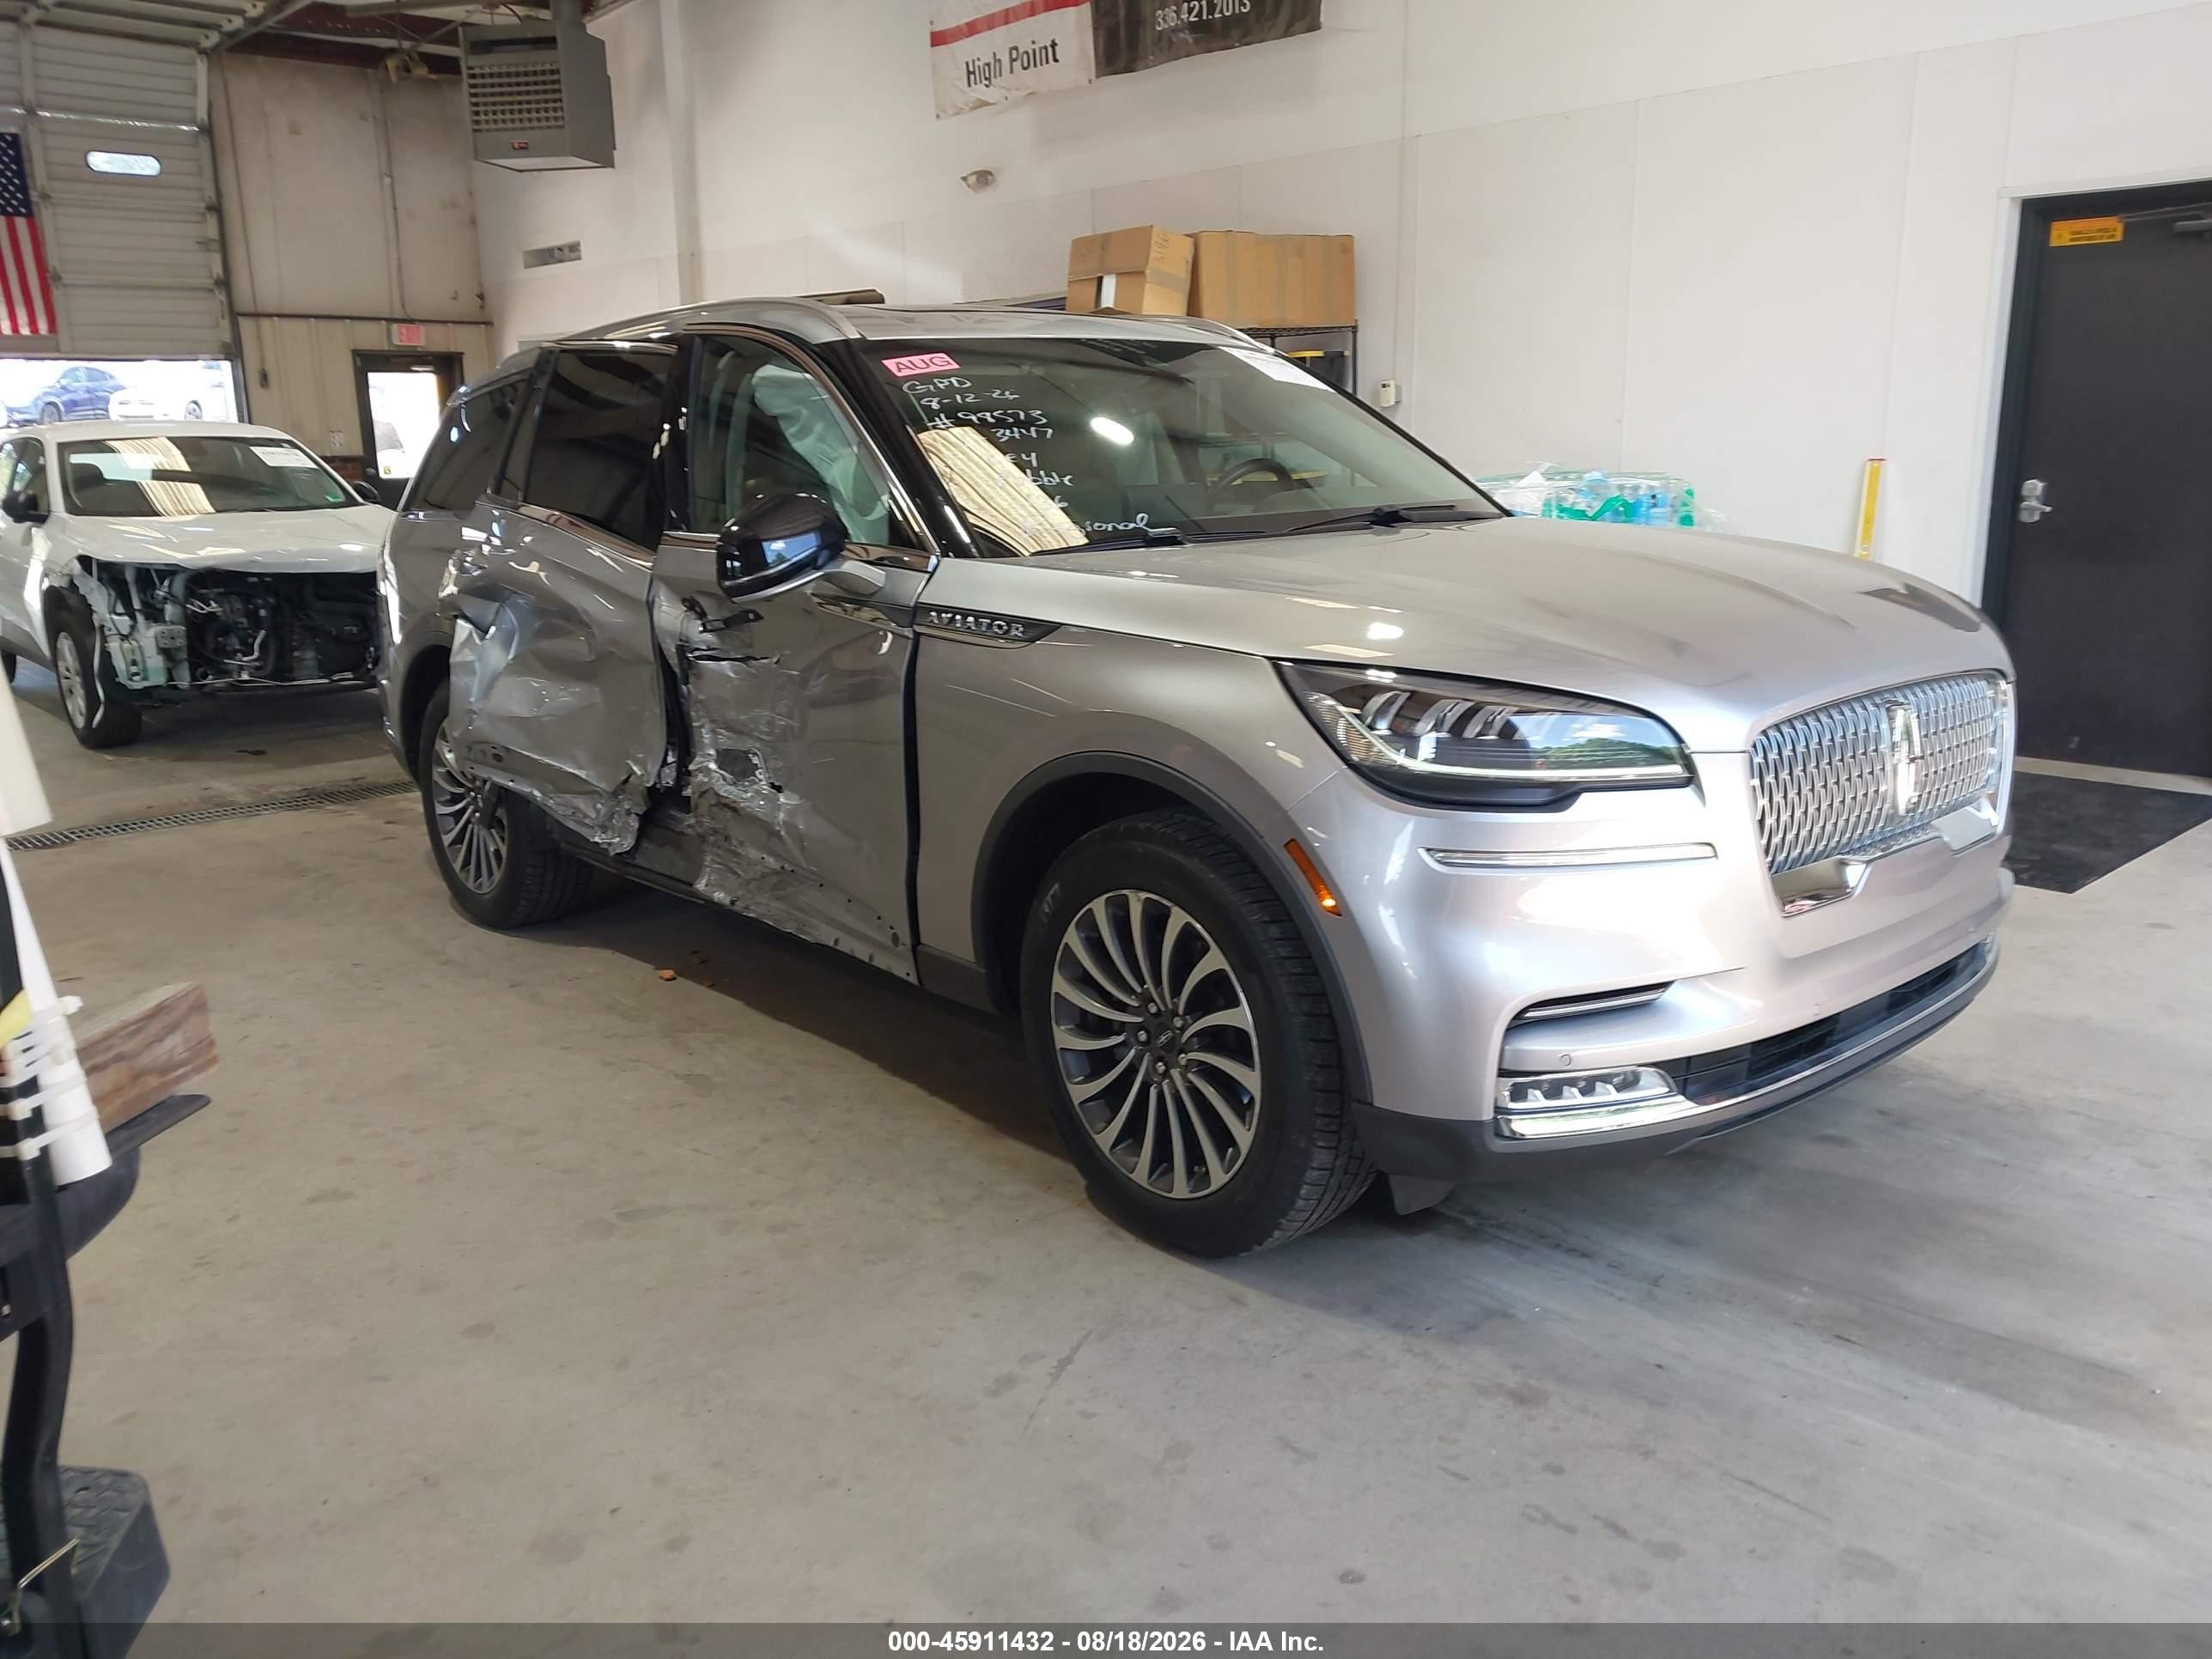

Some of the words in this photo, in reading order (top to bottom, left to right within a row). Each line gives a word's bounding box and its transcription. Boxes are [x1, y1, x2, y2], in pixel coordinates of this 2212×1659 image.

[965, 52, 1003, 88] High
[1008, 38, 1060, 75] Point
[895, 356, 954, 374] AUG
[928, 611, 1024, 638] AVIATOR
